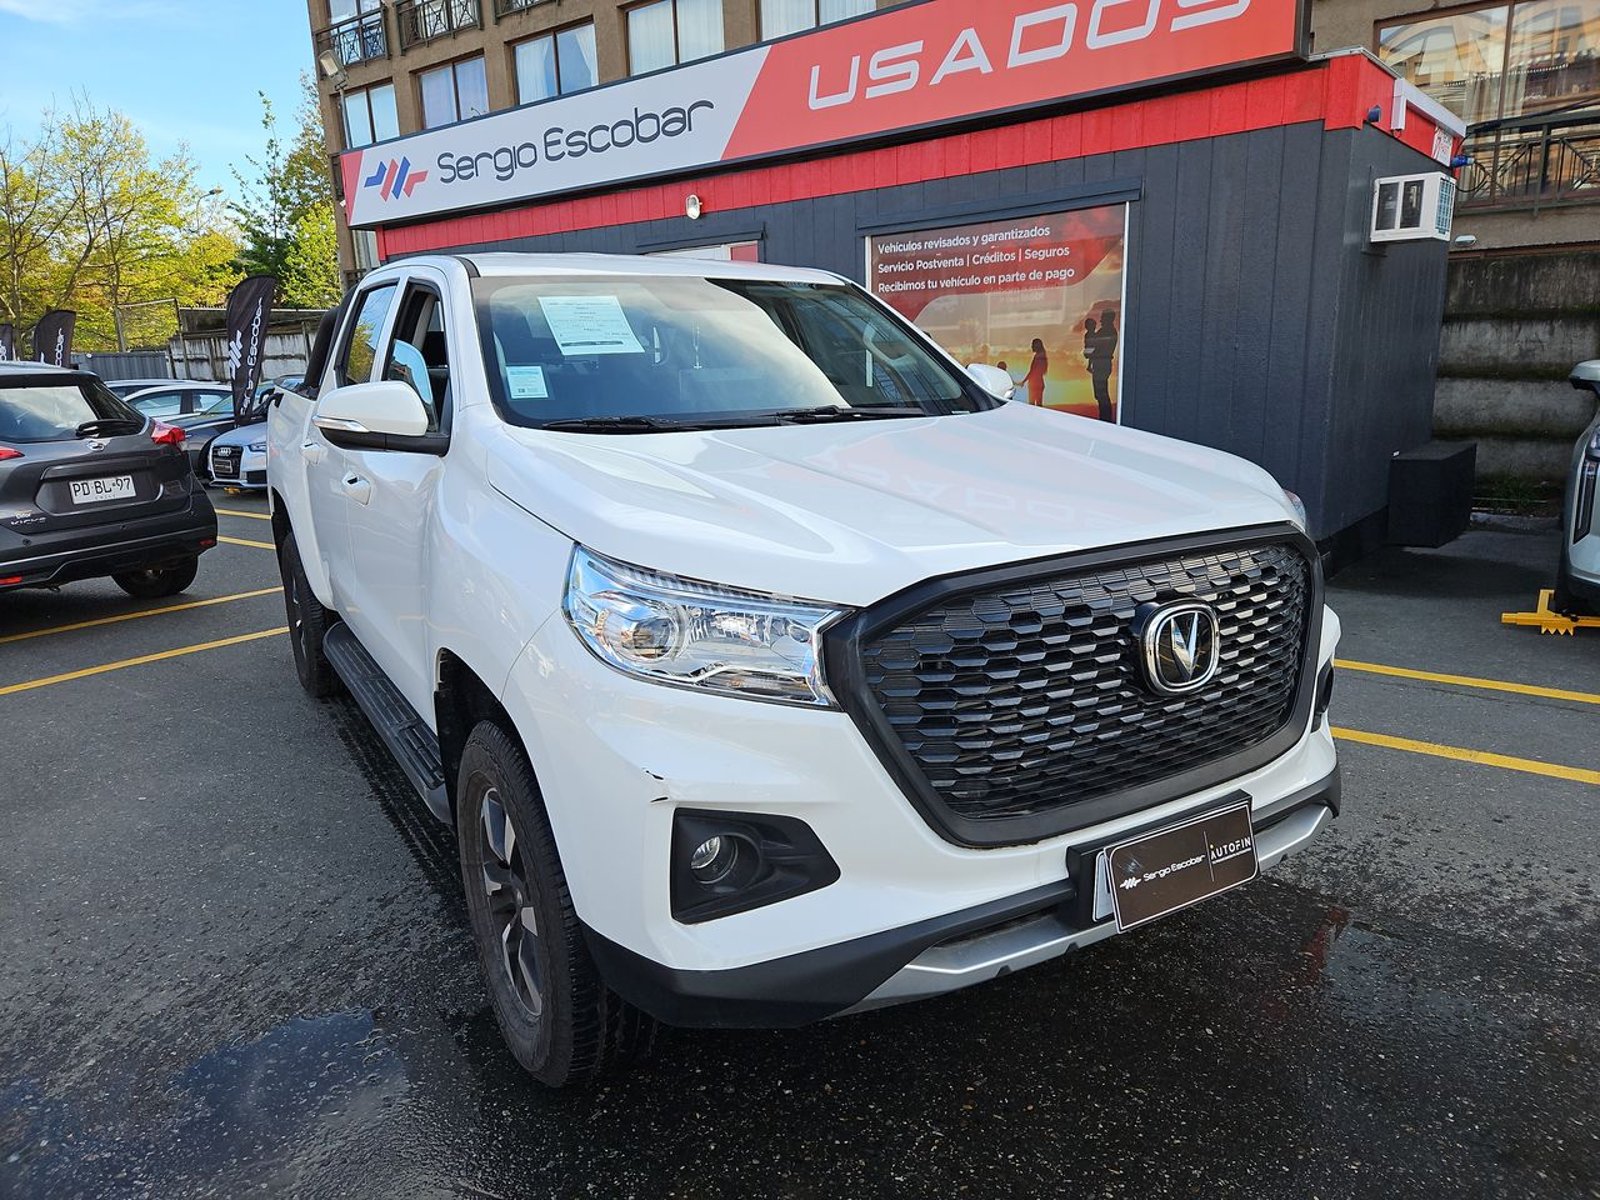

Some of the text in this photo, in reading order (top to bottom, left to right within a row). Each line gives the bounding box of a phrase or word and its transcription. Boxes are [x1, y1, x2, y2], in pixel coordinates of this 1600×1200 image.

[437, 100, 714, 184] Sergio Escobar
[878, 226, 1050, 254] Vehículos revisados y garantizados
[878, 261, 914, 273] Servicio
[916, 257, 964, 271] Postventa
[972, 251, 1016, 265] Créditos
[1024, 247, 1070, 260] Seguros
[878, 268, 1075, 293] Recibimos tu vehículo en parte de pago
[1210, 837, 1251, 860] AUTOFIN
[1170, 854, 1206, 872] Escobar
